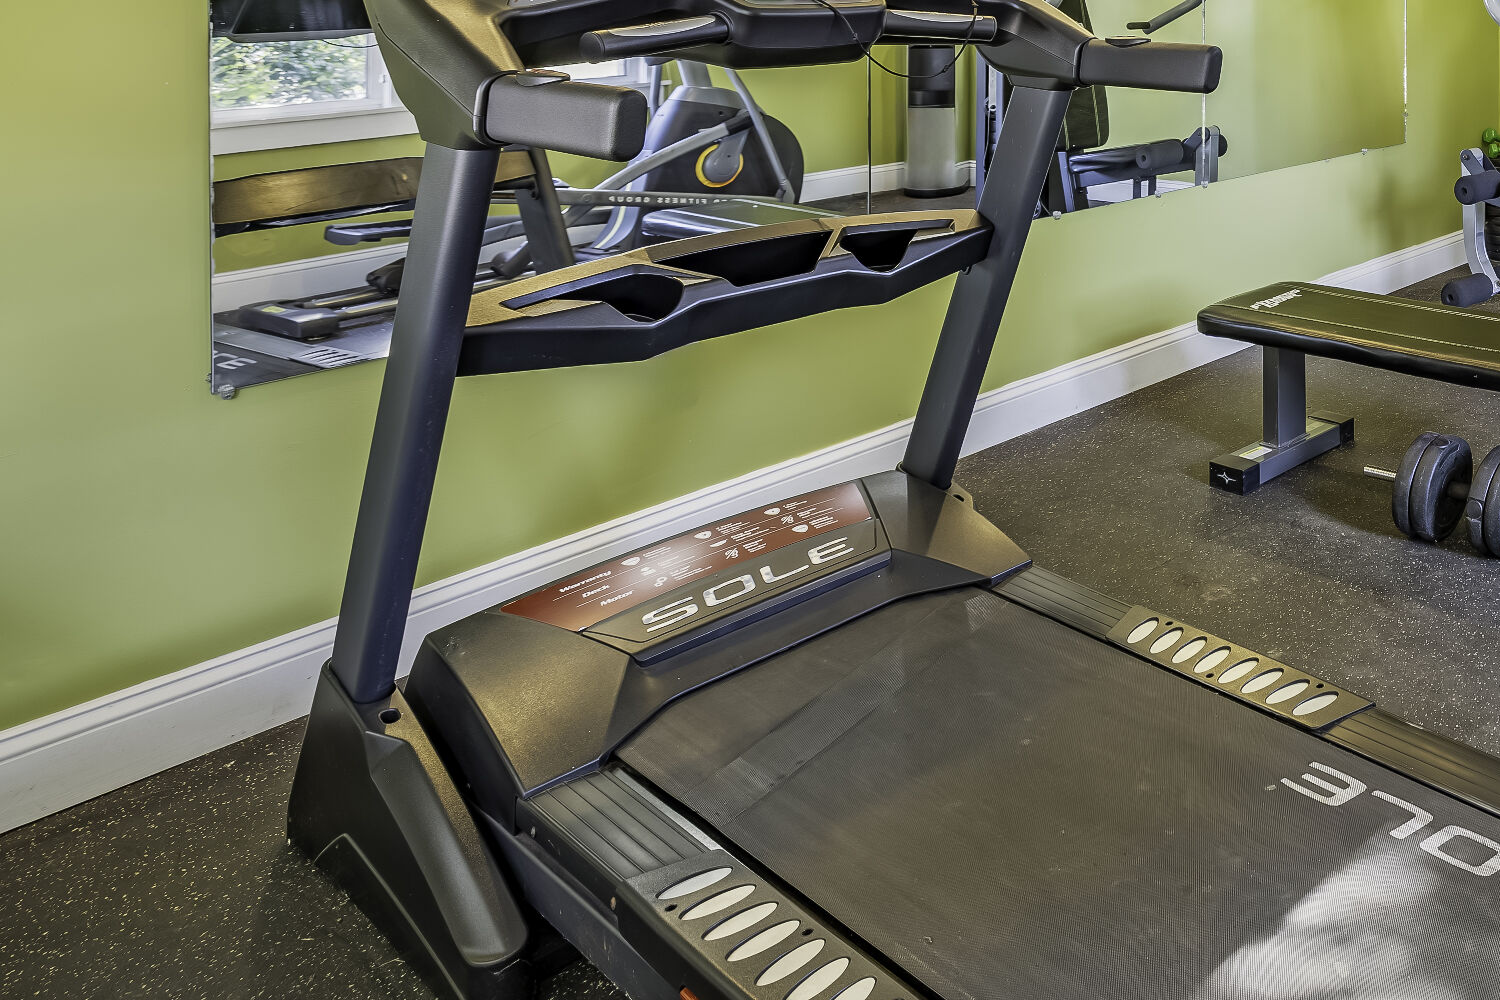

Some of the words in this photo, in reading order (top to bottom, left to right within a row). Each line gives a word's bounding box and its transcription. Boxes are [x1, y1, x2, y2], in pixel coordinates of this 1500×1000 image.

[560, 570, 612, 593] Warranty
[582, 584, 610, 598] Deck
[640, 536, 855, 634] SOLE
[600, 590, 633, 606] Motor
